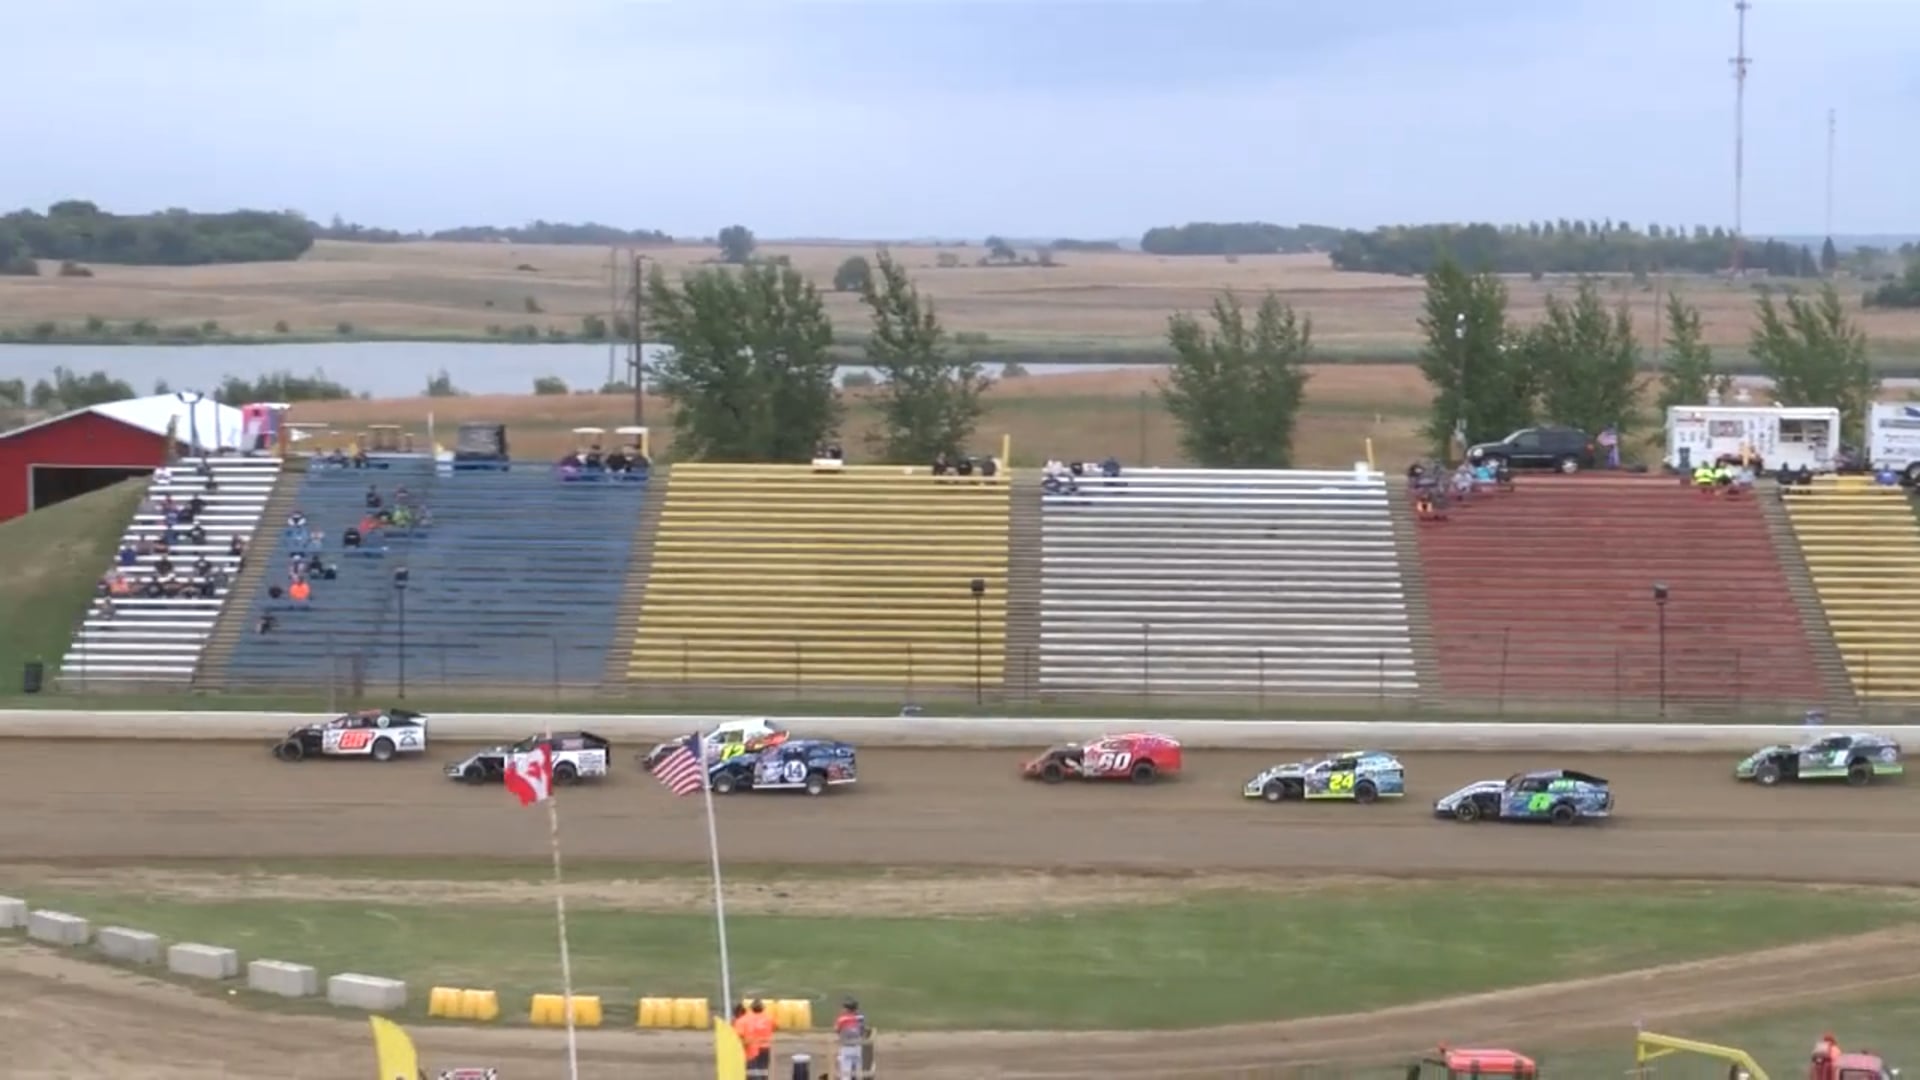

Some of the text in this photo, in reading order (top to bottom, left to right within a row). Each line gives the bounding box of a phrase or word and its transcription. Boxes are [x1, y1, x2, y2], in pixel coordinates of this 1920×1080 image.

[1099, 752, 1131, 771] 60
[787, 763, 802, 778] 14
[1330, 773, 1354, 790] 24
